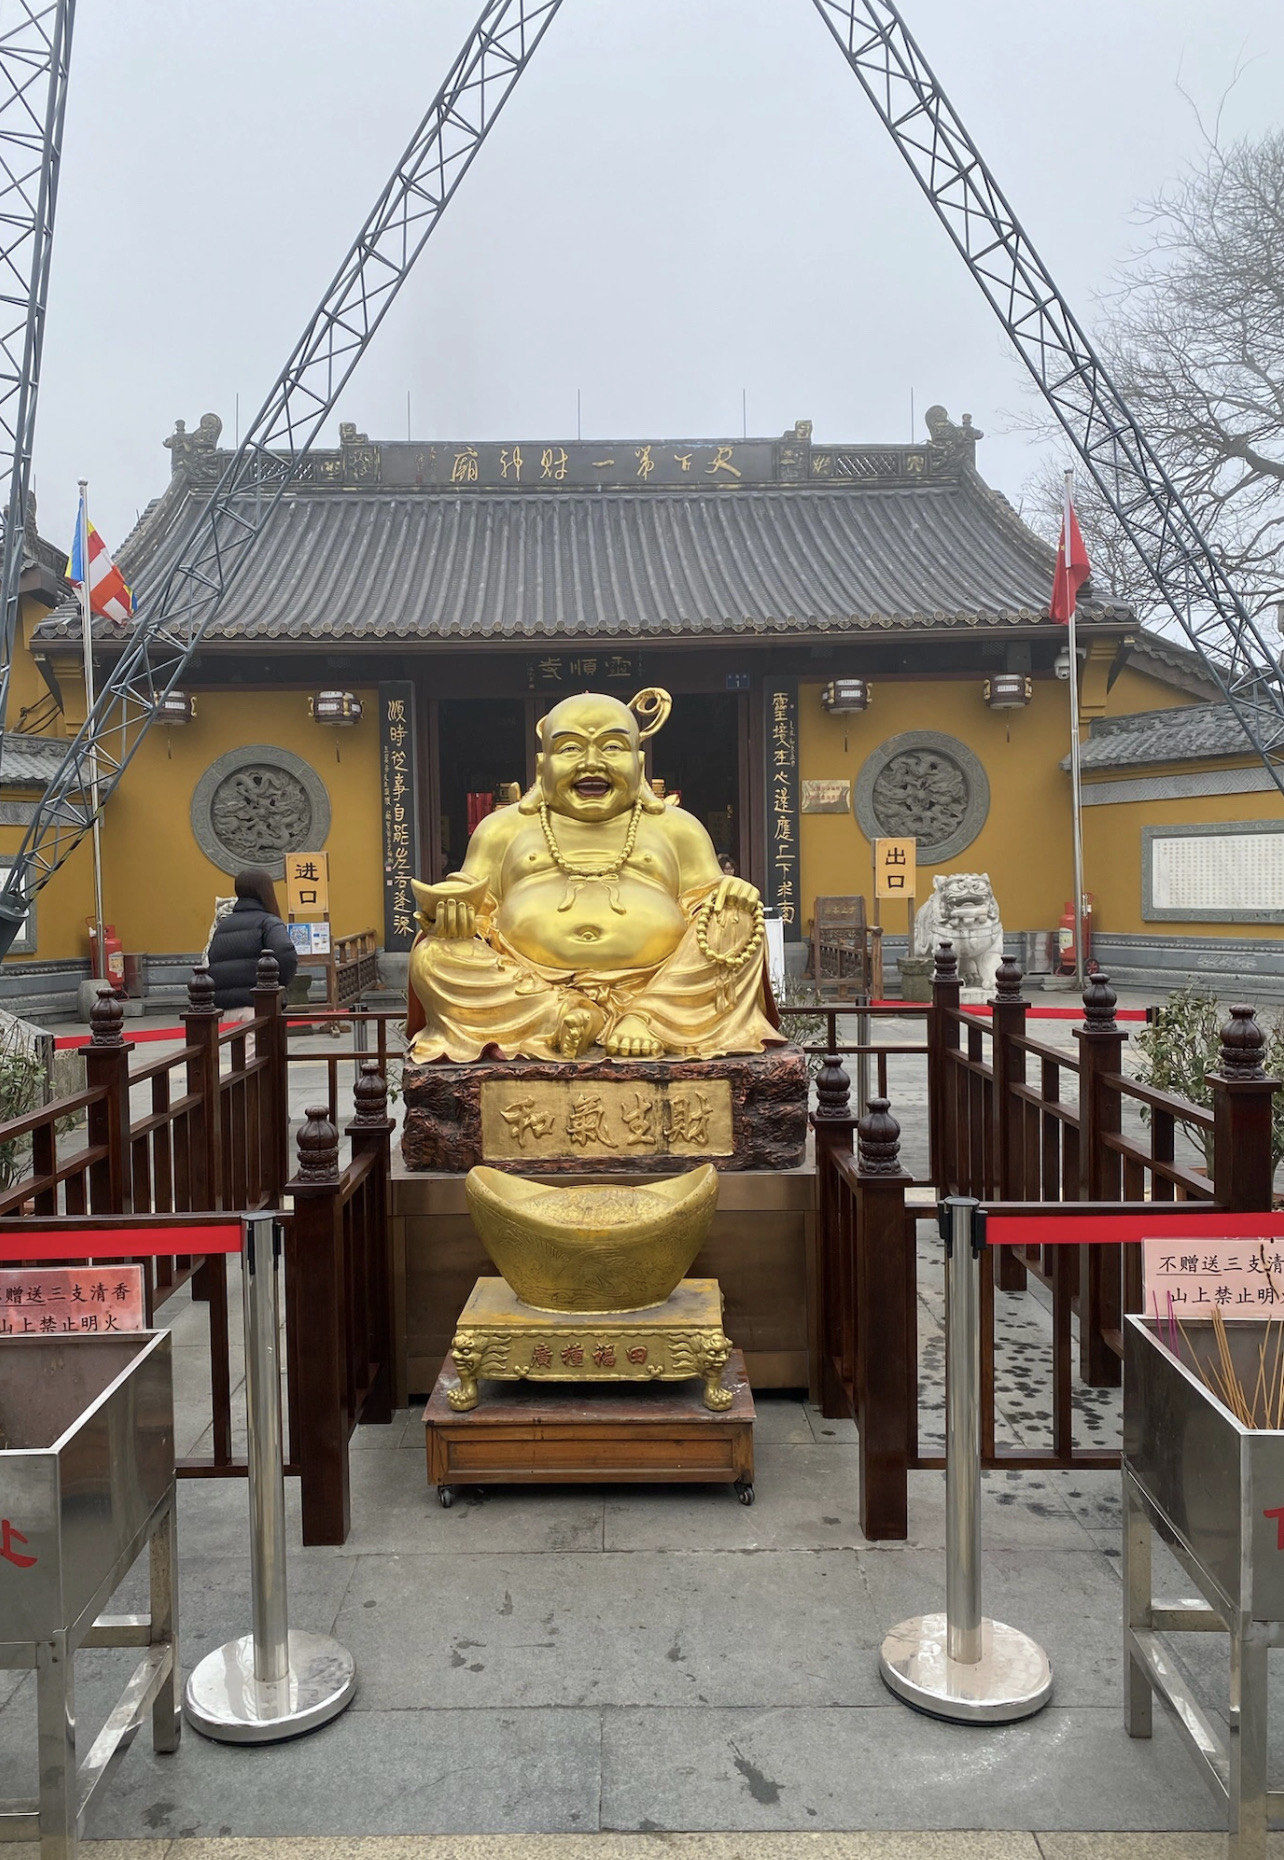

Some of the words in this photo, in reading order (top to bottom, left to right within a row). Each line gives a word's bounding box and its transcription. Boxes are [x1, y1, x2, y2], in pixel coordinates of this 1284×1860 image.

[294, 861, 320, 904] 进口
[885, 847, 906, 889] 出口
[500, 1090, 714, 1149] 和氣生財
[0, 1281, 131, 1305] 赠送三支清香
[1171, 1286, 1284, 1306] 山上禁止明
[529, 1342, 648, 1369] 廣種福田
